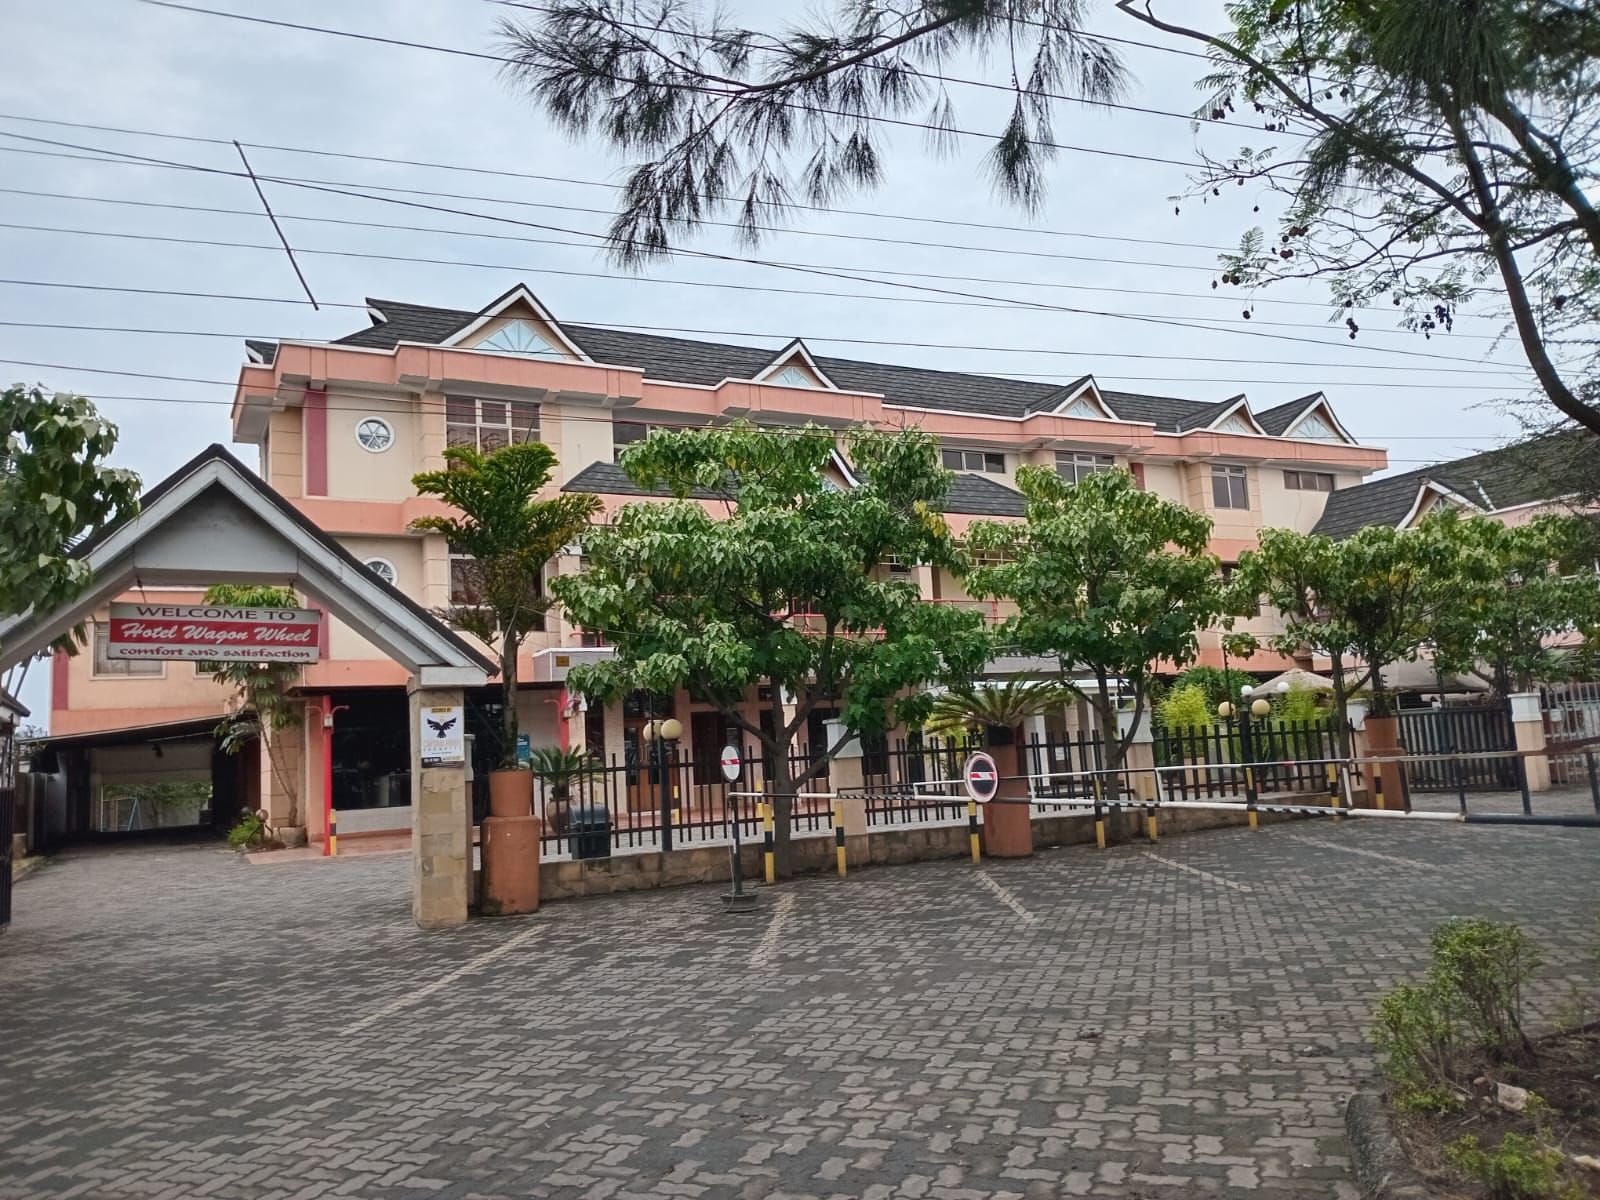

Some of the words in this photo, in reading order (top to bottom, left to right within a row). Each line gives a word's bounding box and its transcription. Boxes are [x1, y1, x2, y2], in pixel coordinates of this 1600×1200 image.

[136, 606, 256, 620] WELCOME
[264, 611, 295, 621] TO
[121, 623, 177, 639] Hotel
[182, 625, 248, 644] Wagon
[254, 627, 311, 642] Wheel
[119, 646, 183, 656] comfort
[187, 648, 218, 656] and
[223, 648, 310, 658] satisfaction
